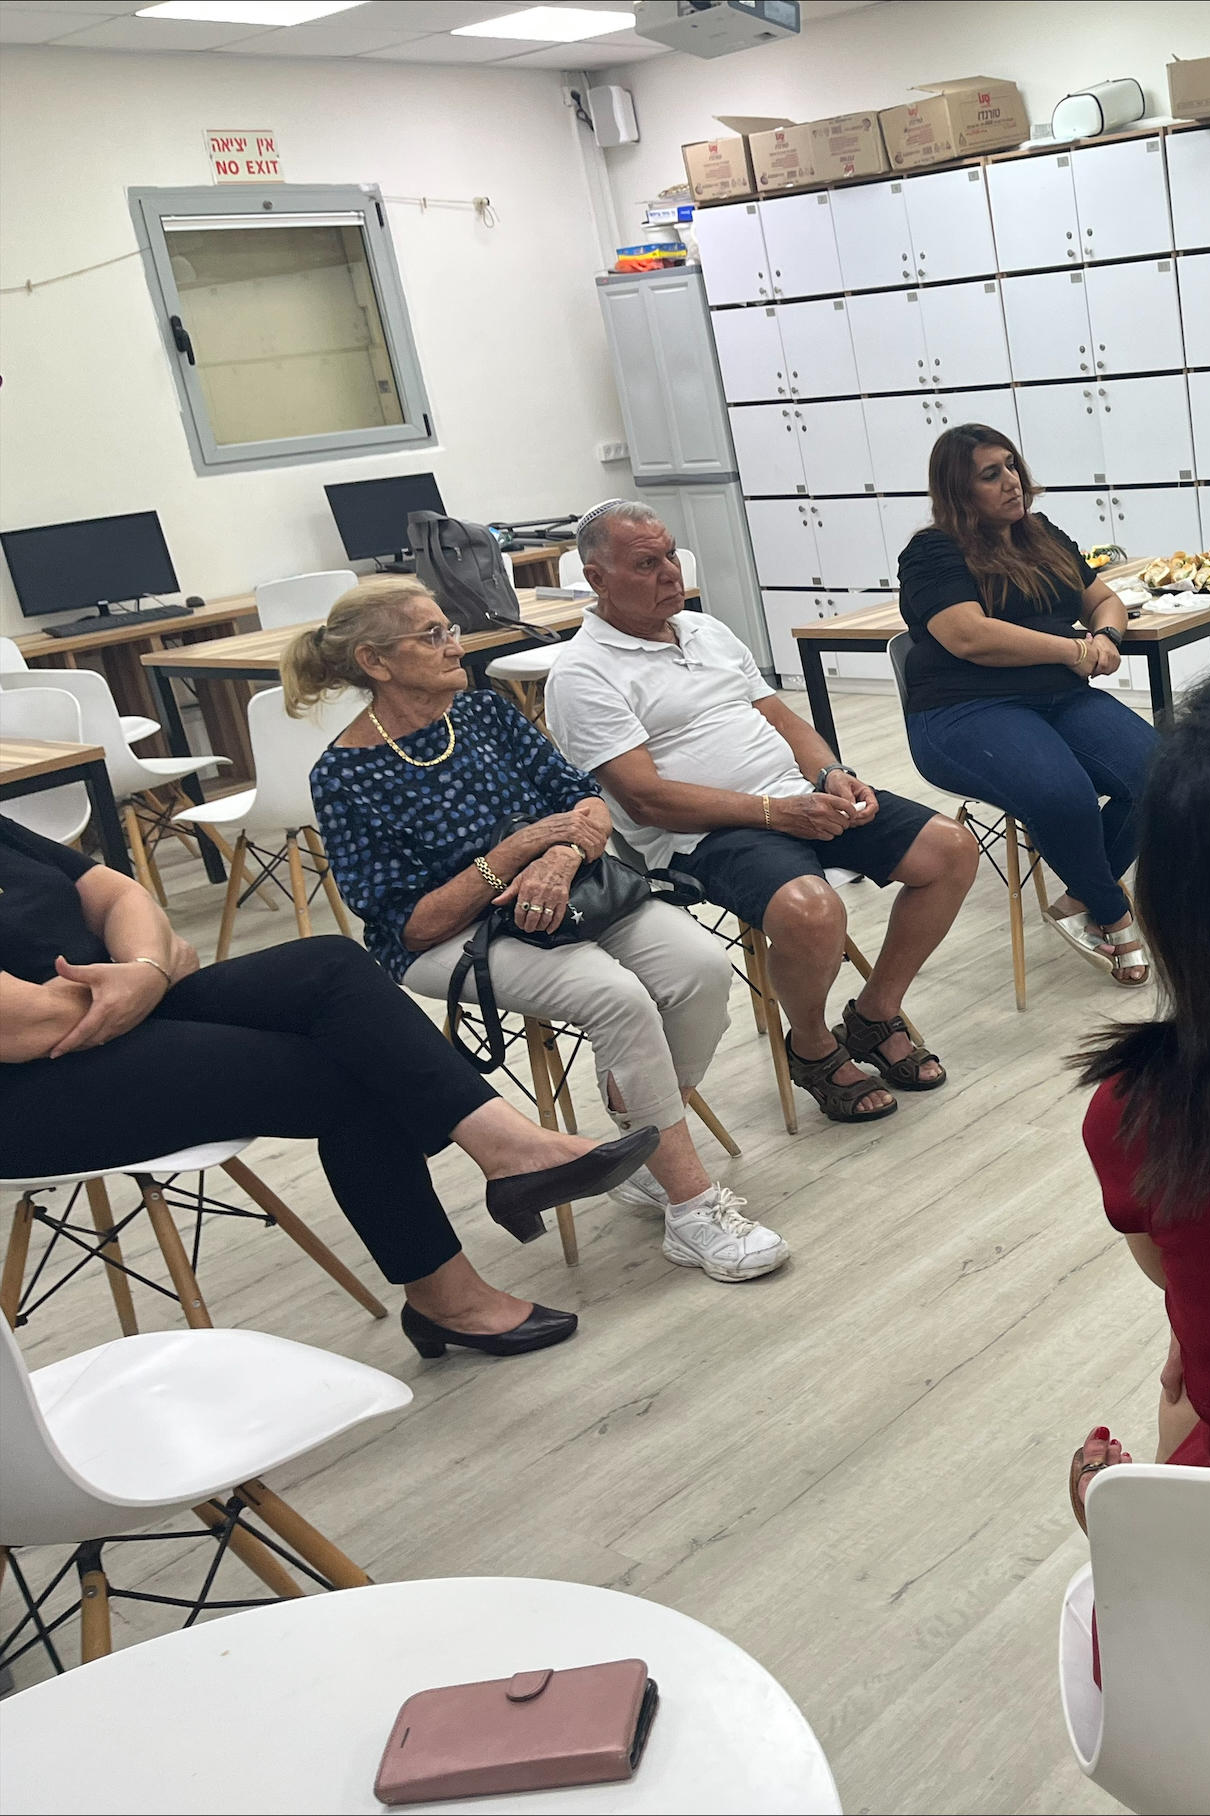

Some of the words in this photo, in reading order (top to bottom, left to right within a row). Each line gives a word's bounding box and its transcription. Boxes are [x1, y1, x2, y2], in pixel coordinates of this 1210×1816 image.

[977, 108, 1001, 121] טורנדו
[210, 137, 247, 153] יציאה
[256, 137, 275, 157] אין
[215, 160, 240, 175] NO
[246, 160, 278, 175] EXIT
